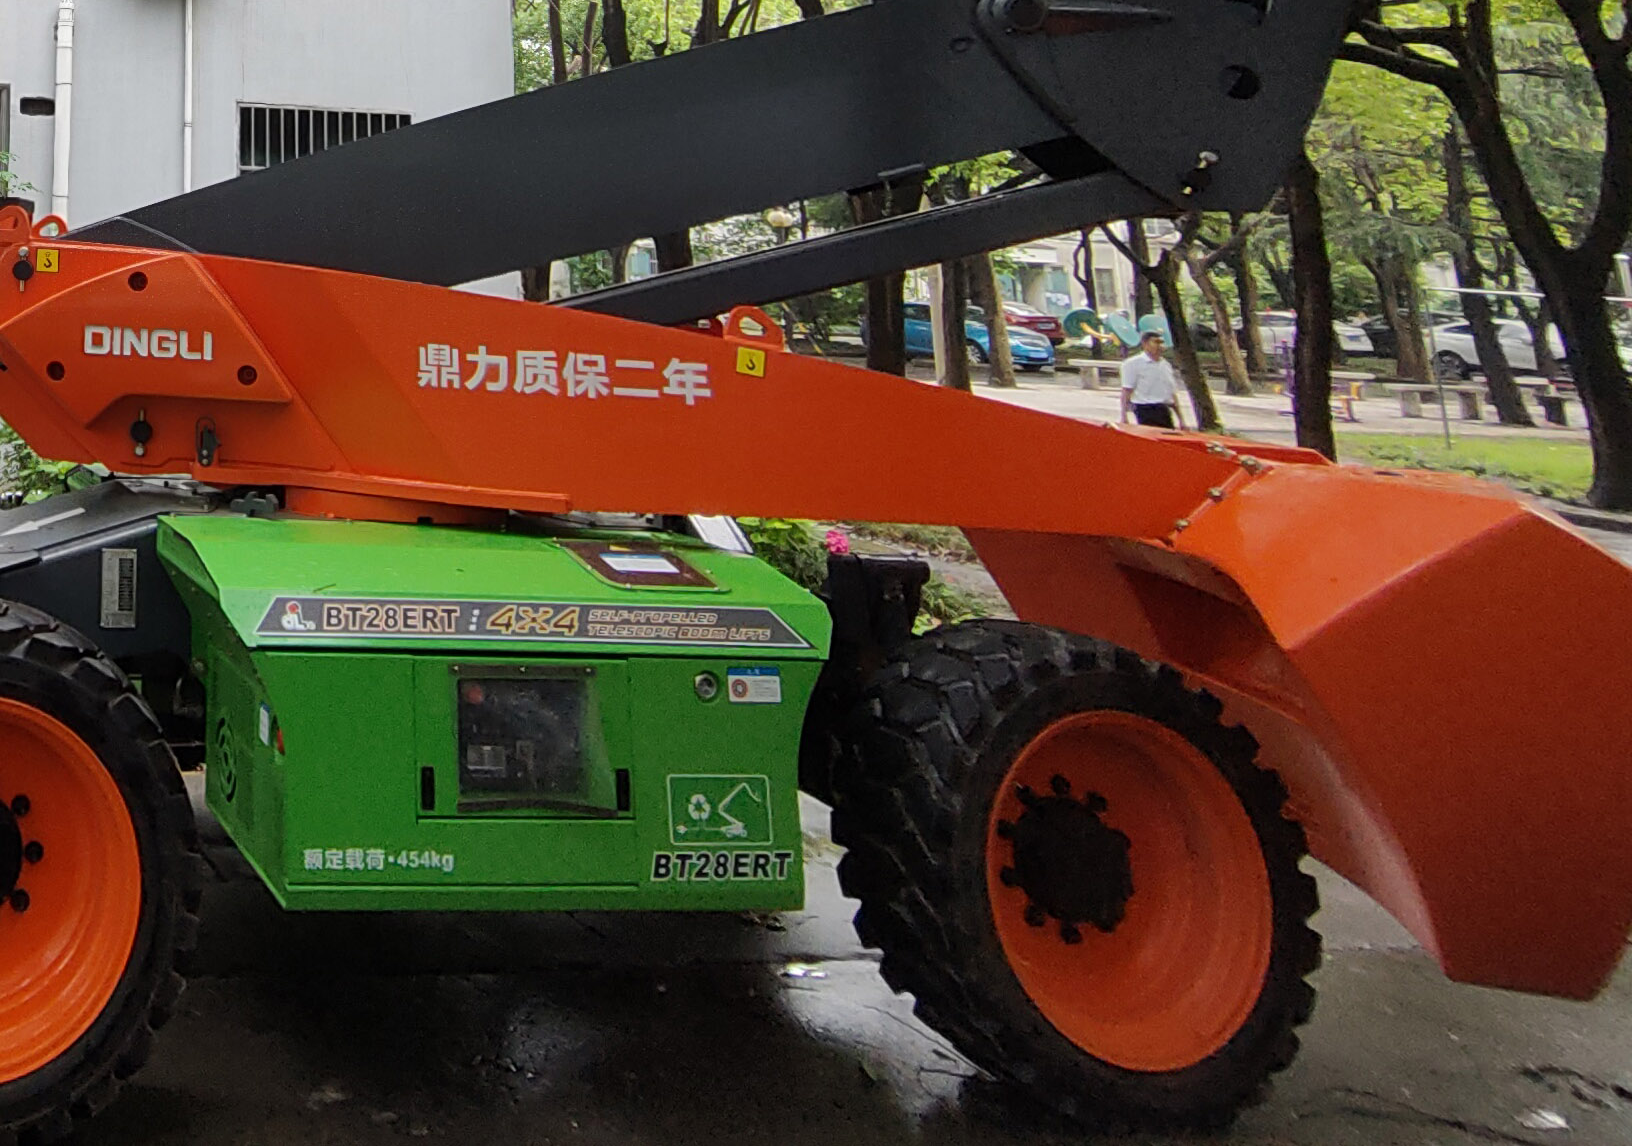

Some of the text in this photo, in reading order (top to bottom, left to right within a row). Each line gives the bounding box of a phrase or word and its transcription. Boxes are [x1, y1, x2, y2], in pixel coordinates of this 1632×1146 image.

[84, 325, 214, 361] DINGLI
[418, 343, 712, 406] 鼎力质保二年
[323, 603, 461, 633] BT28ERT
[651, 851, 794, 881] BT28ERT
